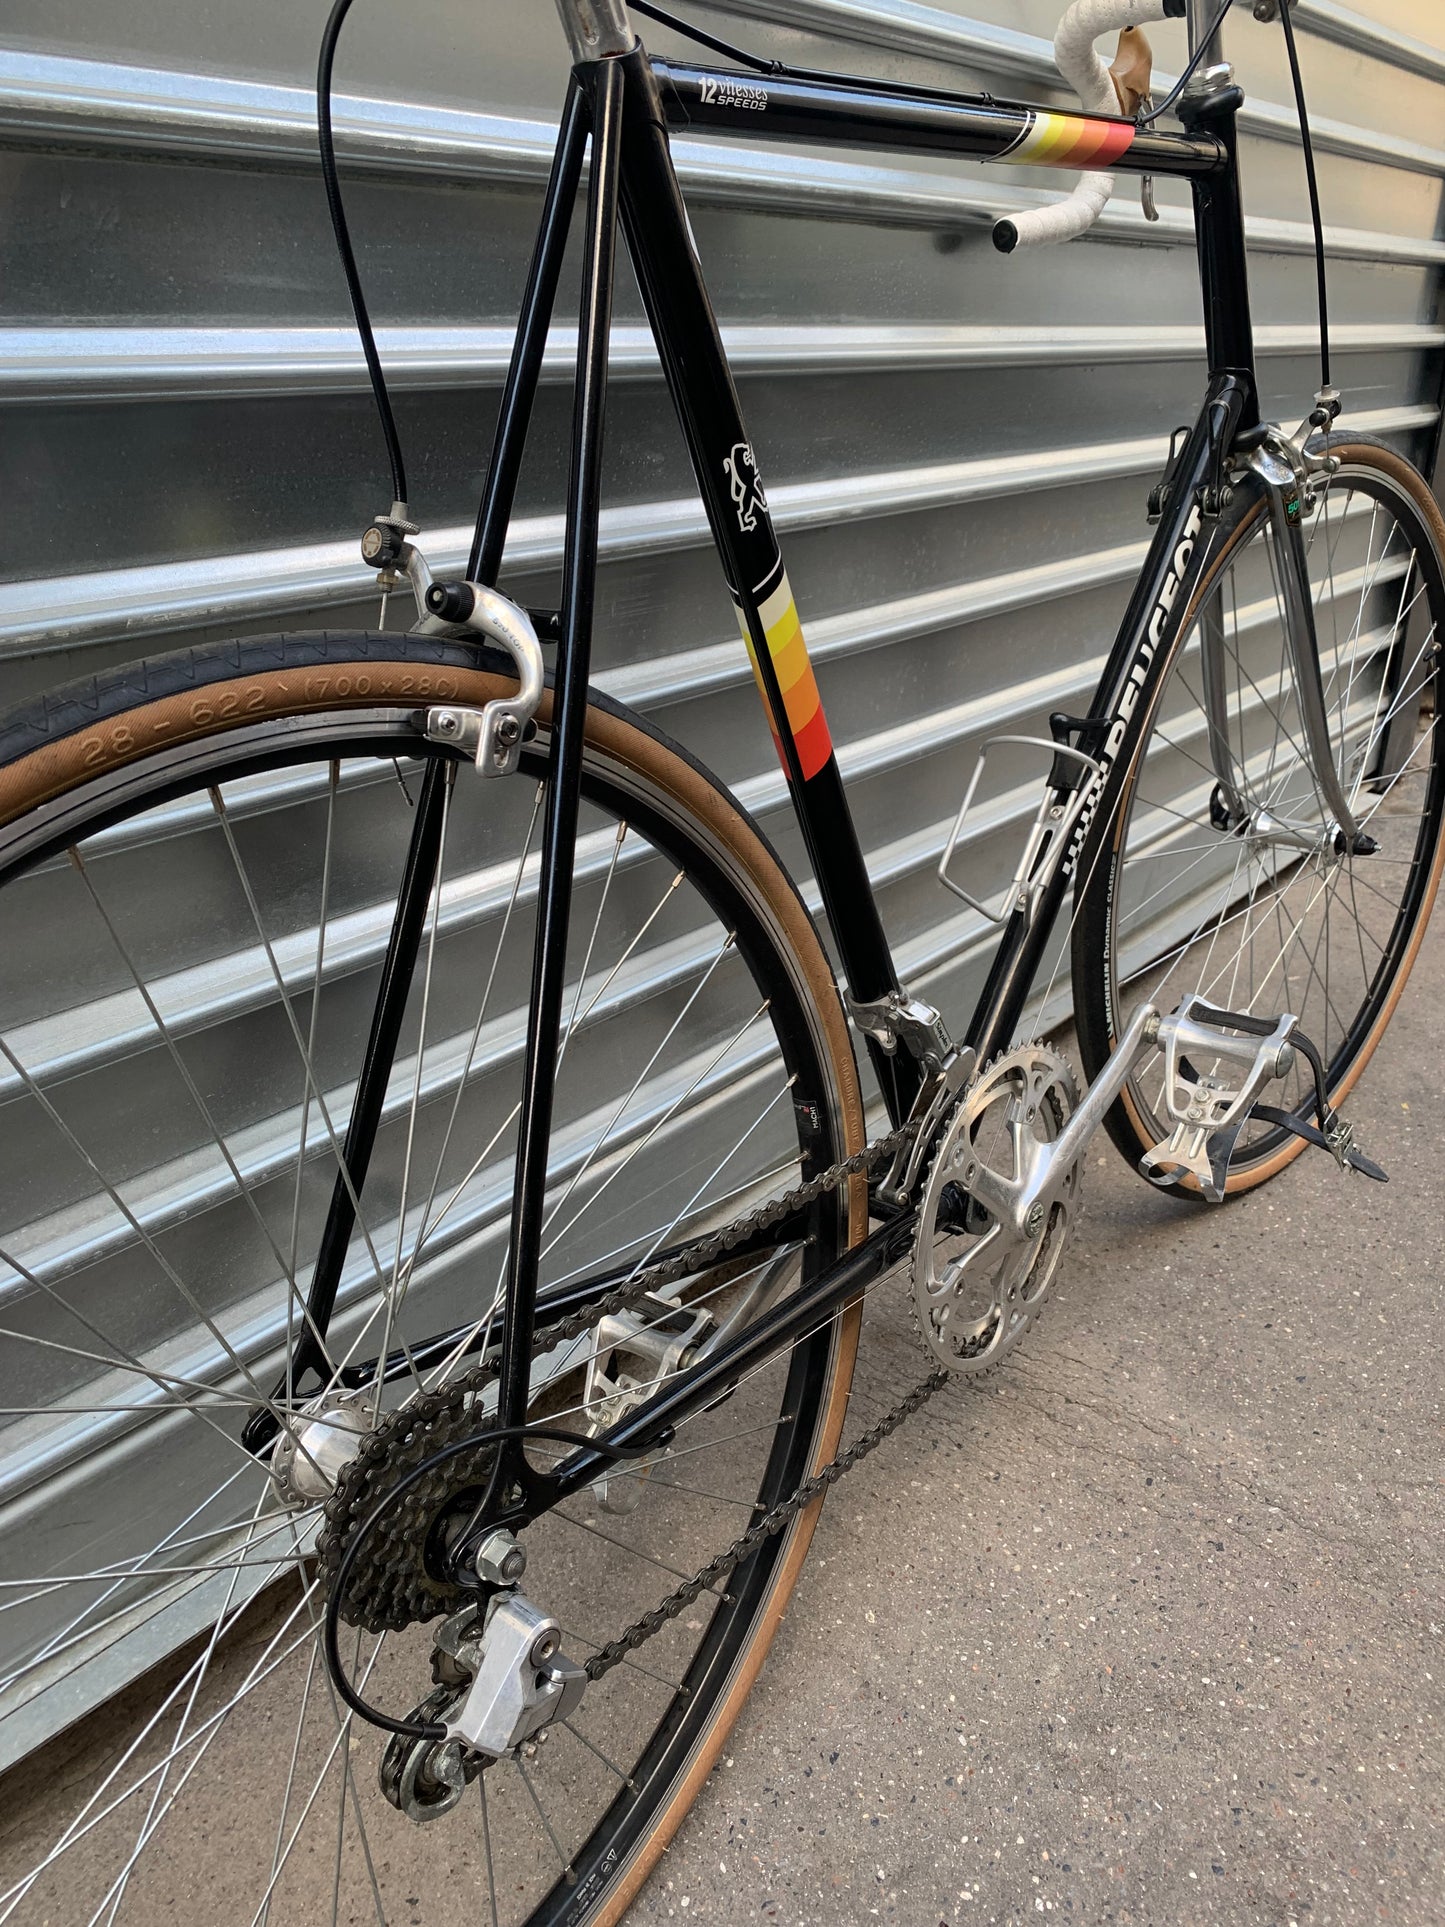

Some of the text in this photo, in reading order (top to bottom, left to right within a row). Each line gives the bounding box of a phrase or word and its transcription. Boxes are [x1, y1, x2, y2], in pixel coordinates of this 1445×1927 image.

[698, 77, 768, 104] 12 vitesses
[717, 95, 767, 111] SPEEDS
[1103, 504, 1200, 760] PEUGEOT
[80, 723, 136, 768] 28
[188, 685, 267, 726] 622
[1106, 863, 1116, 903] CLASSIC
[1103, 961, 1113, 1024] MICHELIN
[810, 1106, 819, 1129] MACH1
